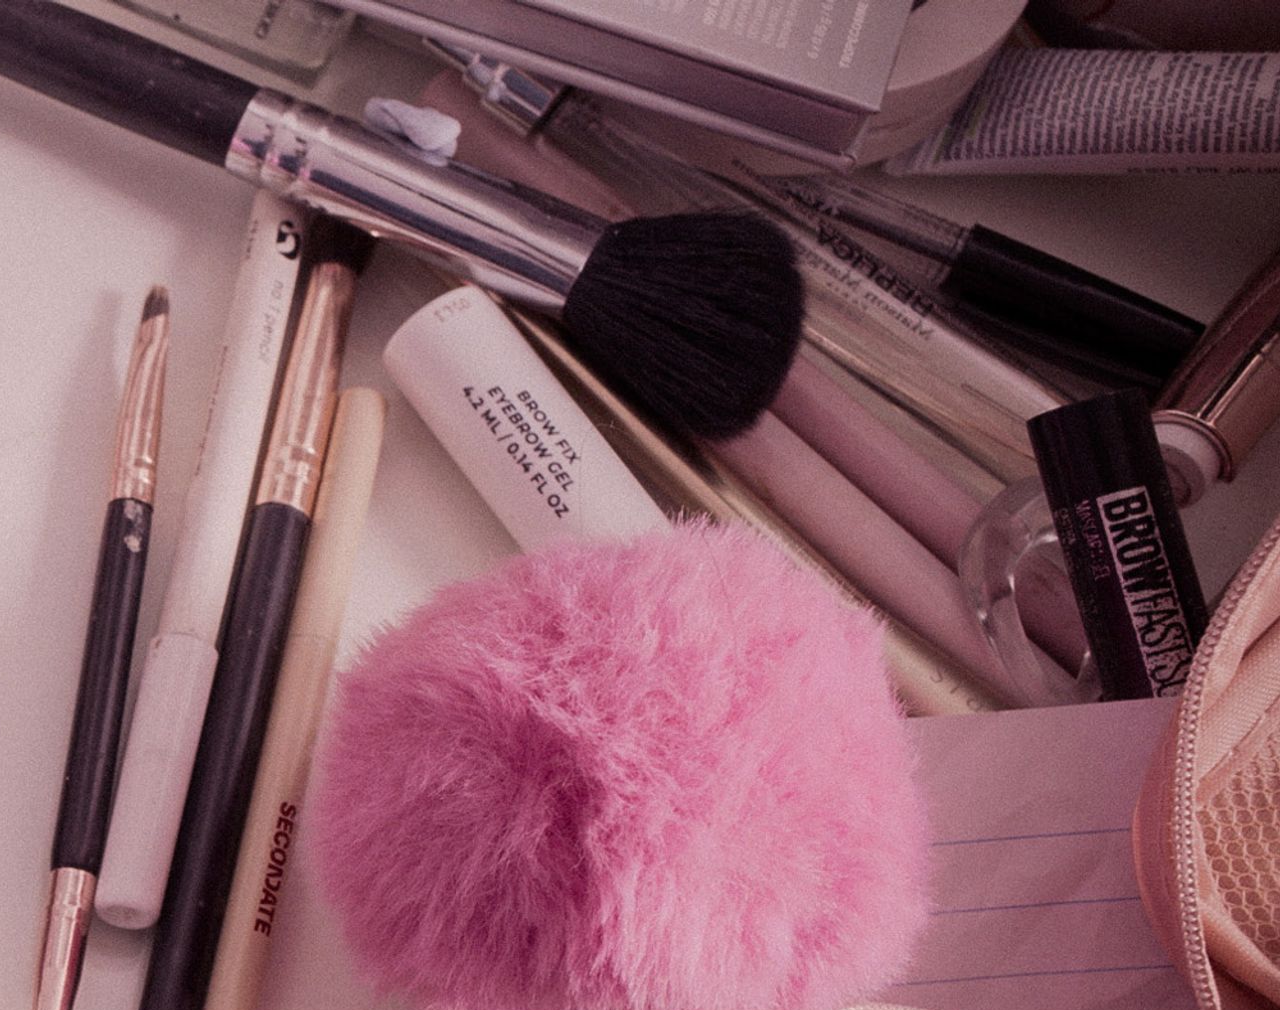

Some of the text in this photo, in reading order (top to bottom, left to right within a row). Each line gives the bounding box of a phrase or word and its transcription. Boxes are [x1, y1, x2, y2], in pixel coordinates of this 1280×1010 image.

[462, 385, 485, 411] 4.2
[481, 409, 503, 435] ML
[507, 443, 533, 474] 0.14
[530, 472, 546, 495] FL
[546, 493, 570, 519] OZ
[487, 385, 575, 492] EYEBROW GEL
[518, 390, 582, 465] BROW FIX
